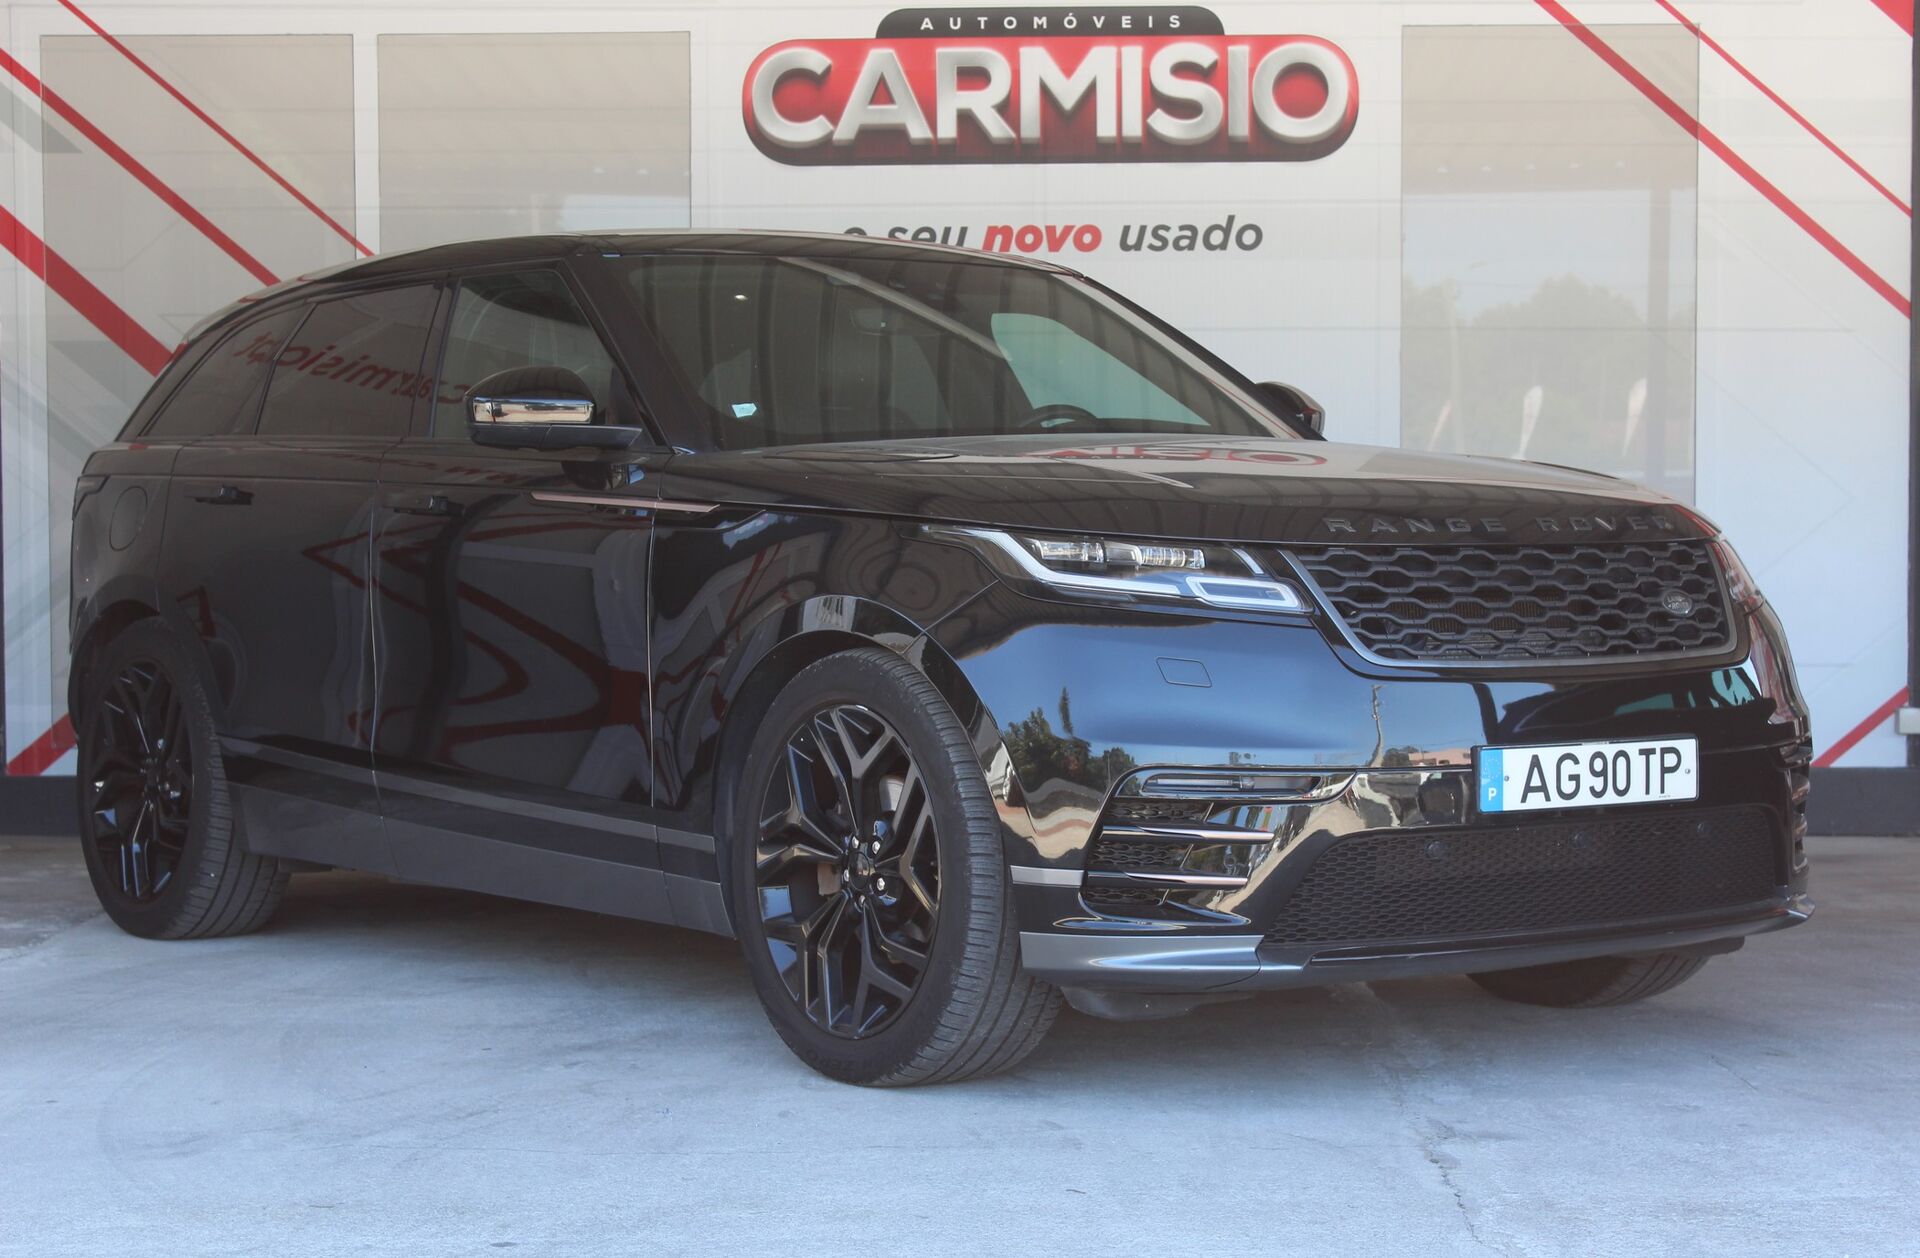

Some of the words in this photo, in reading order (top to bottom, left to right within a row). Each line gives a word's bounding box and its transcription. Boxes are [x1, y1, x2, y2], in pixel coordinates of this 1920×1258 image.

[920, 12, 1182, 30] AUTOMÓVEIS
[751, 43, 1349, 147] CARMISIO
[982, 224, 1103, 253] novo
[1119, 215, 1263, 252] usado
[1323, 517, 1506, 532] RANGE
[1536, 515, 1674, 531] ROVER
[1487, 787, 1497, 801] P
